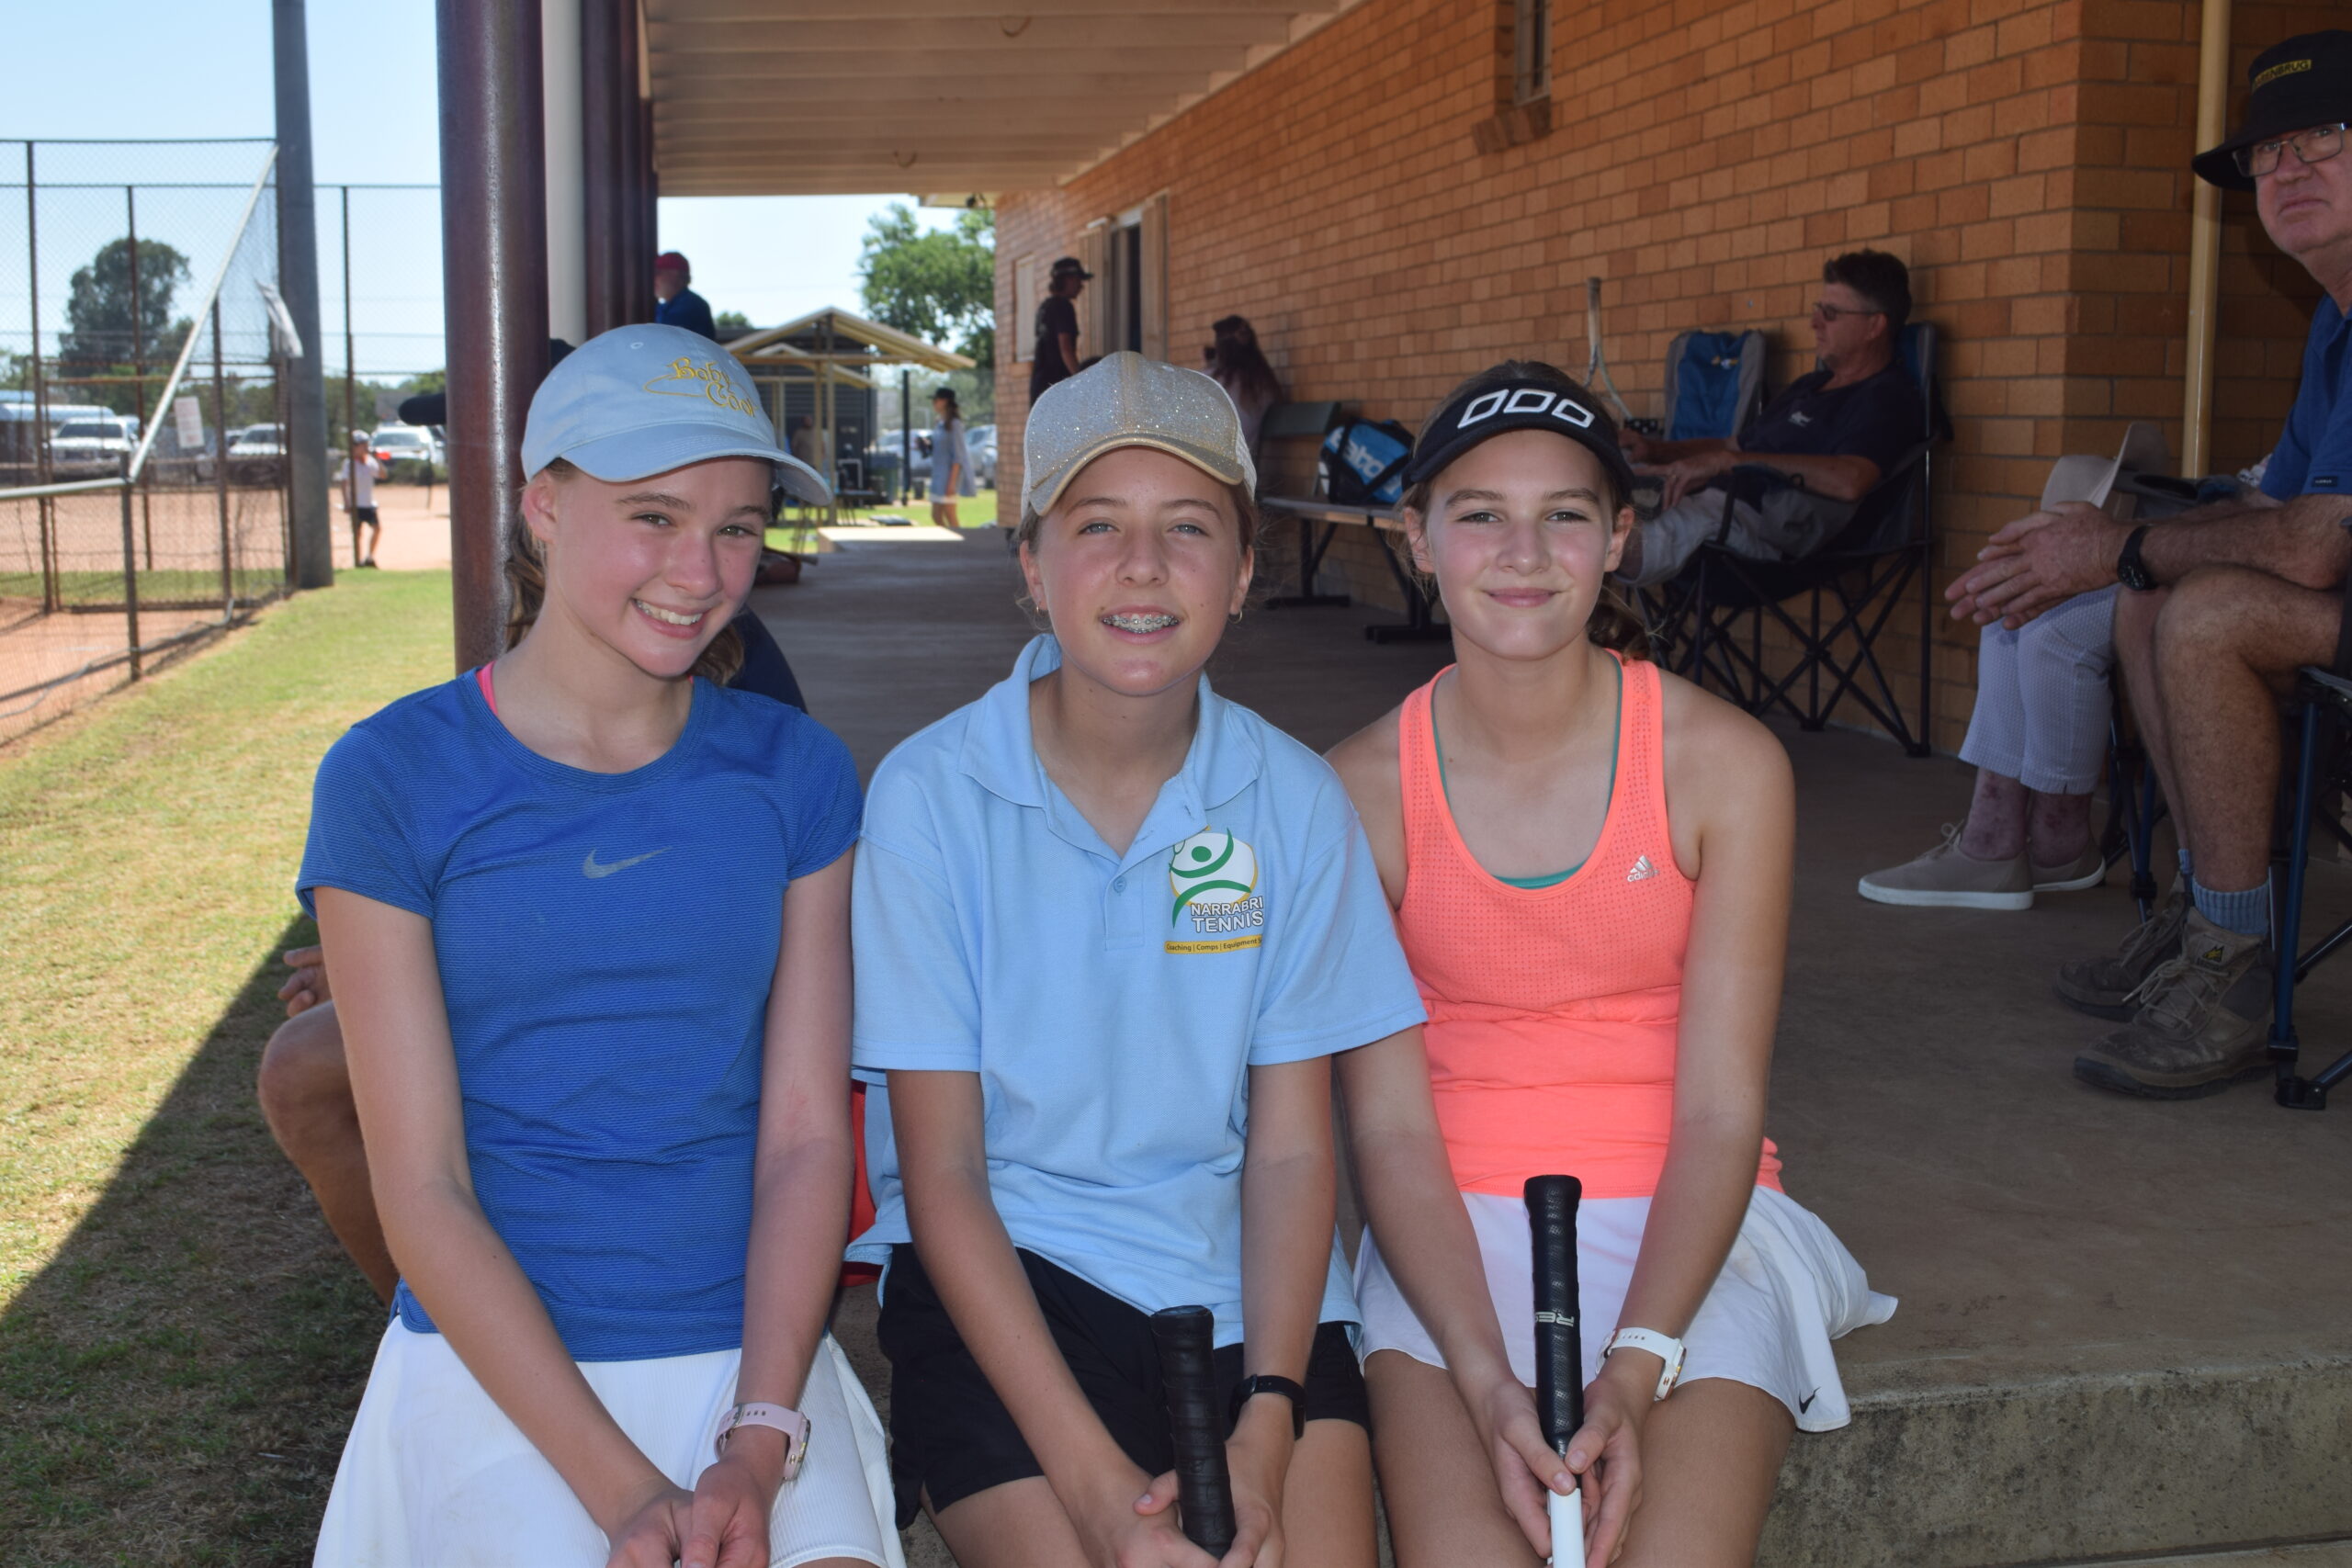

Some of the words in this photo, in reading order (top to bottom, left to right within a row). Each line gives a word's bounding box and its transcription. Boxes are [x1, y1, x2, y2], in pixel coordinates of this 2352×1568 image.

[667, 356, 734, 395] Baby
[706, 381, 756, 418] Cool
[1191, 896, 1263, 917] NARRABRI
[1192, 910, 1264, 933] TENNIS
[1196, 943, 1218, 952] Comps
[1223, 939, 1257, 950] Equipment
